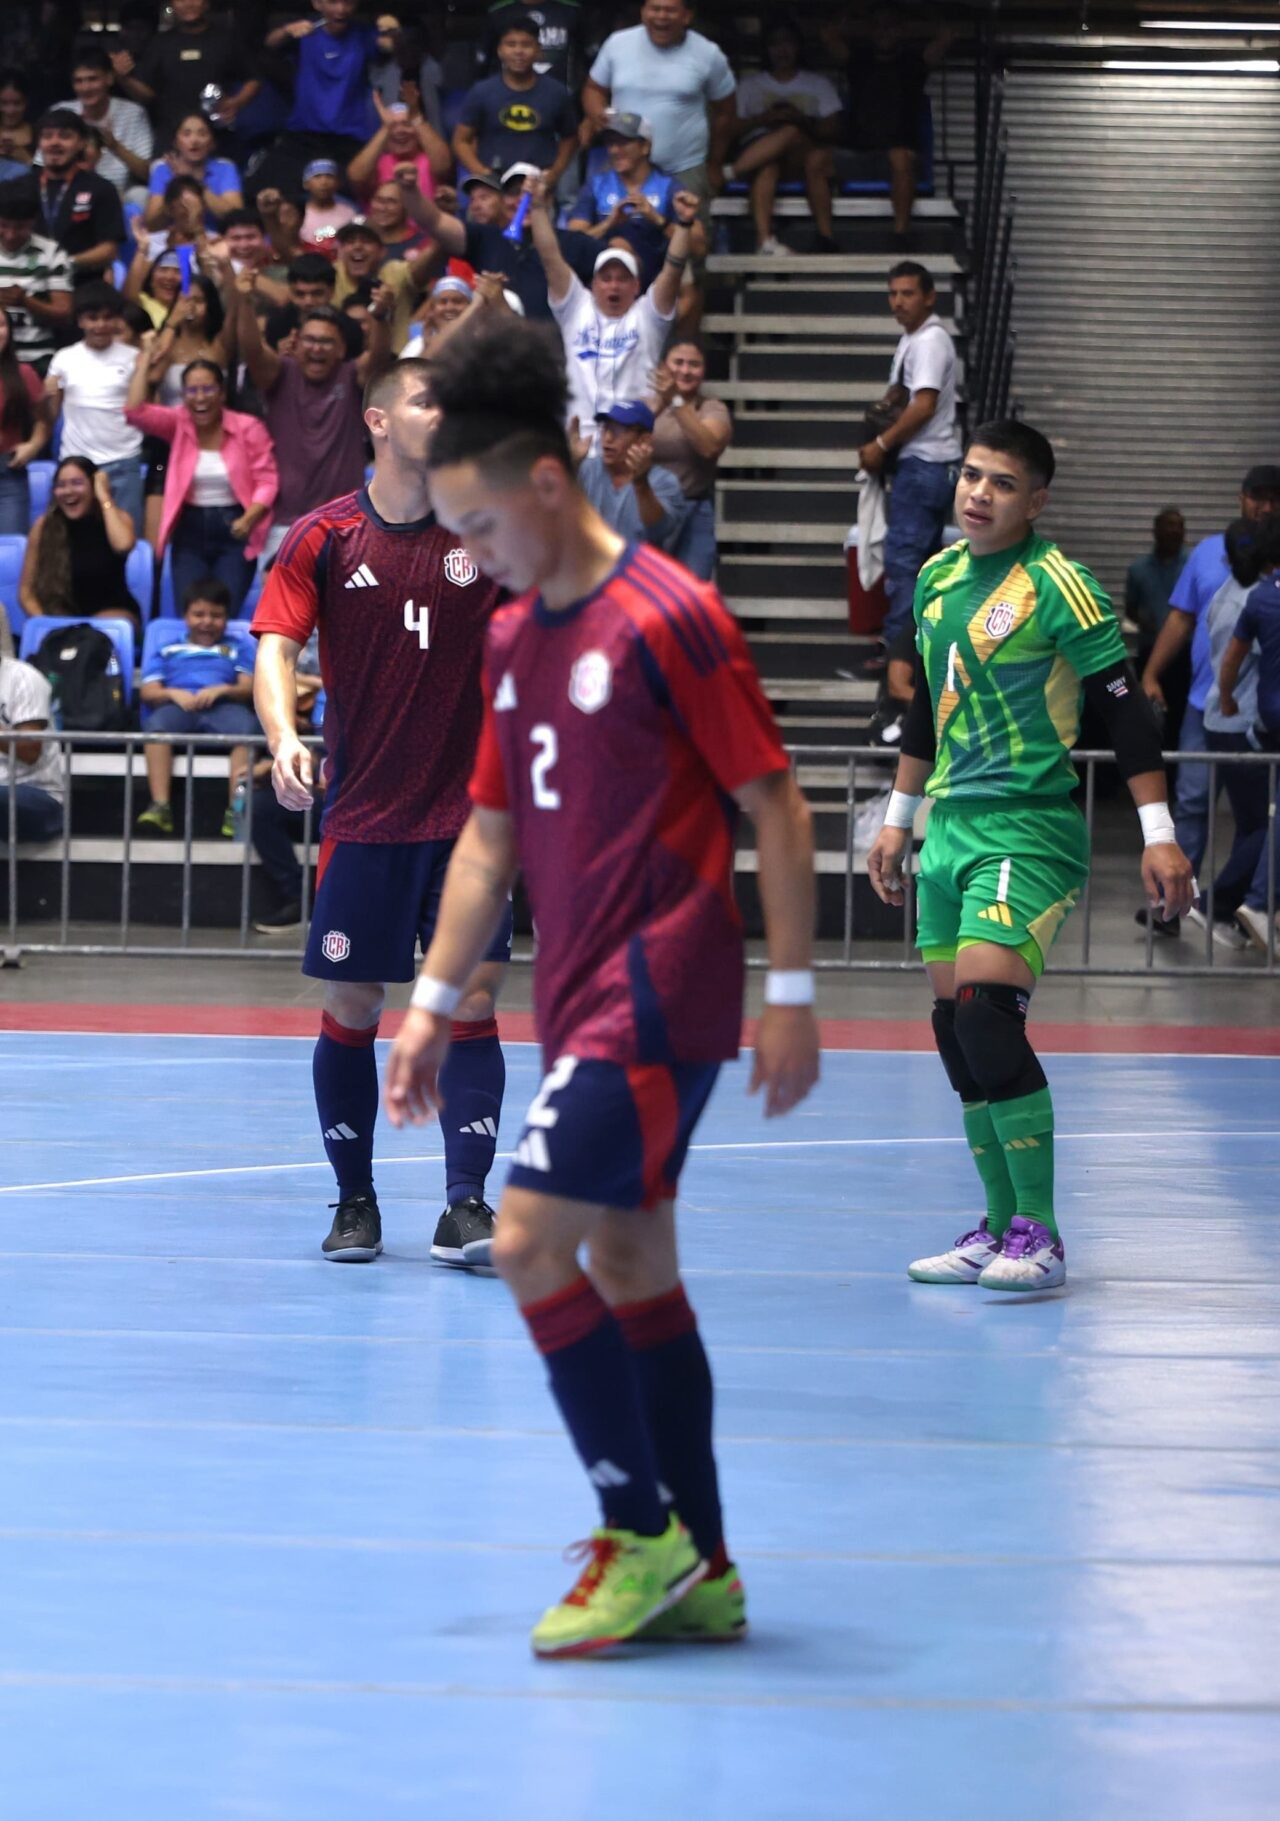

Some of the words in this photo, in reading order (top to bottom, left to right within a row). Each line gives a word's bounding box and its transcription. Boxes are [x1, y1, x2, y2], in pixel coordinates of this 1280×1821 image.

[404, 599, 429, 649] 4
[947, 641, 957, 691] 1
[530, 722, 561, 810] 2
[996, 857, 1011, 902] 1
[526, 1054, 577, 1128] 2
